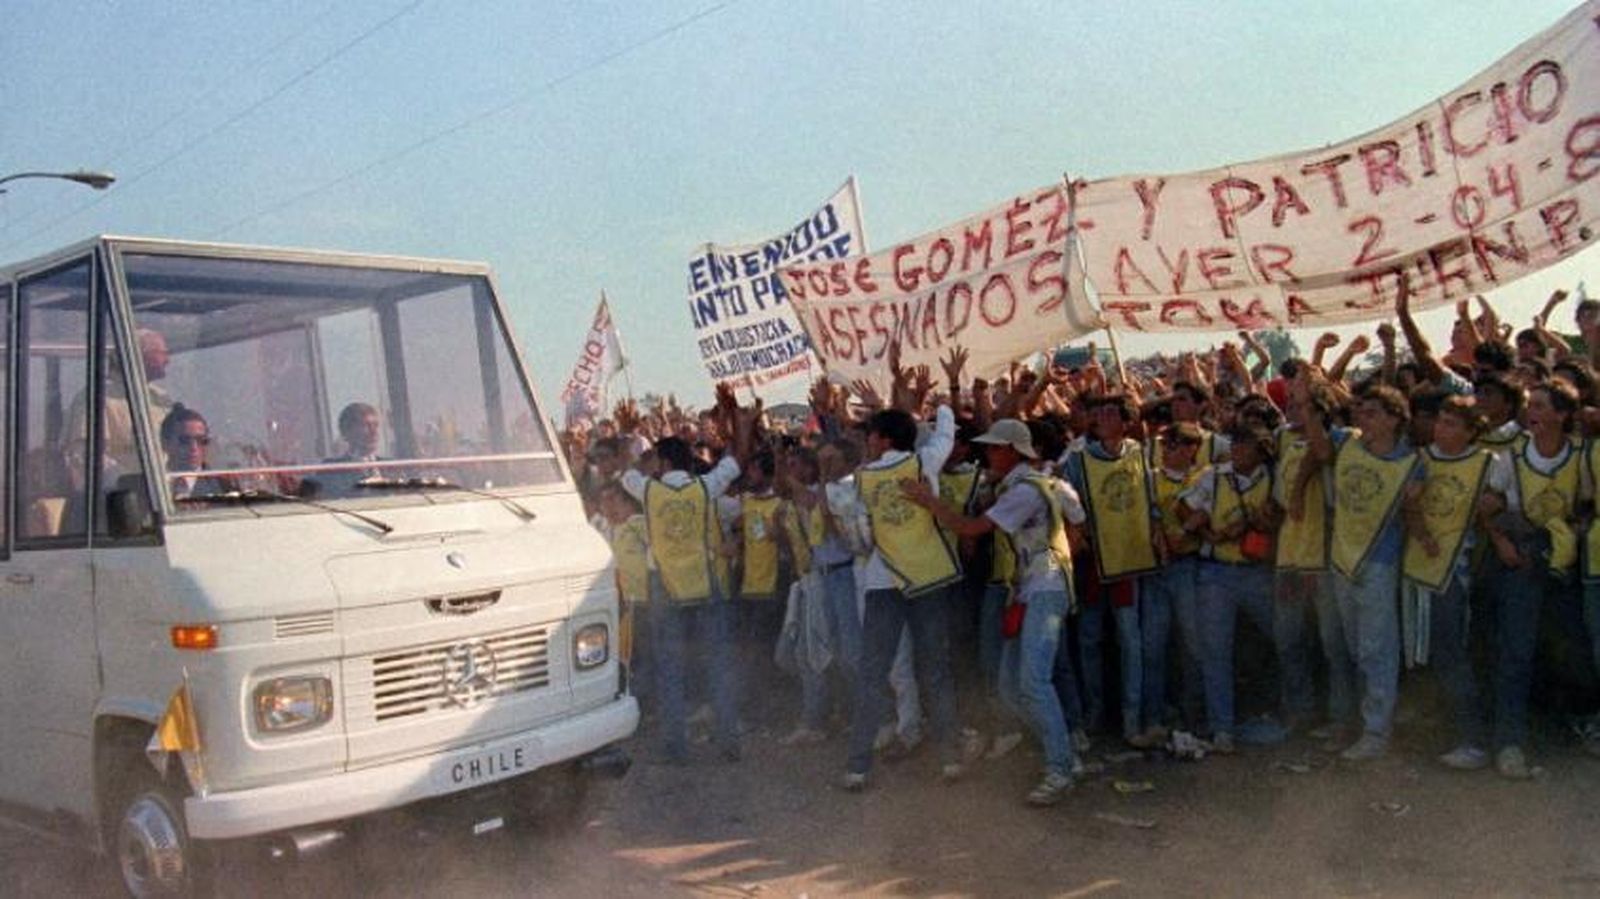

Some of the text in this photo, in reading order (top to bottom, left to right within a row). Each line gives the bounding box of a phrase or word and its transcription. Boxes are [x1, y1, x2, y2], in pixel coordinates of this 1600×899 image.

[788, 258, 878, 299] JOSE
[1133, 178, 1166, 240] Y
[1208, 60, 1567, 239] PATRICIO
[813, 250, 1068, 367] ASESINADOS
[1114, 244, 1301, 296] AYER
[452, 748, 523, 784] CHILE
